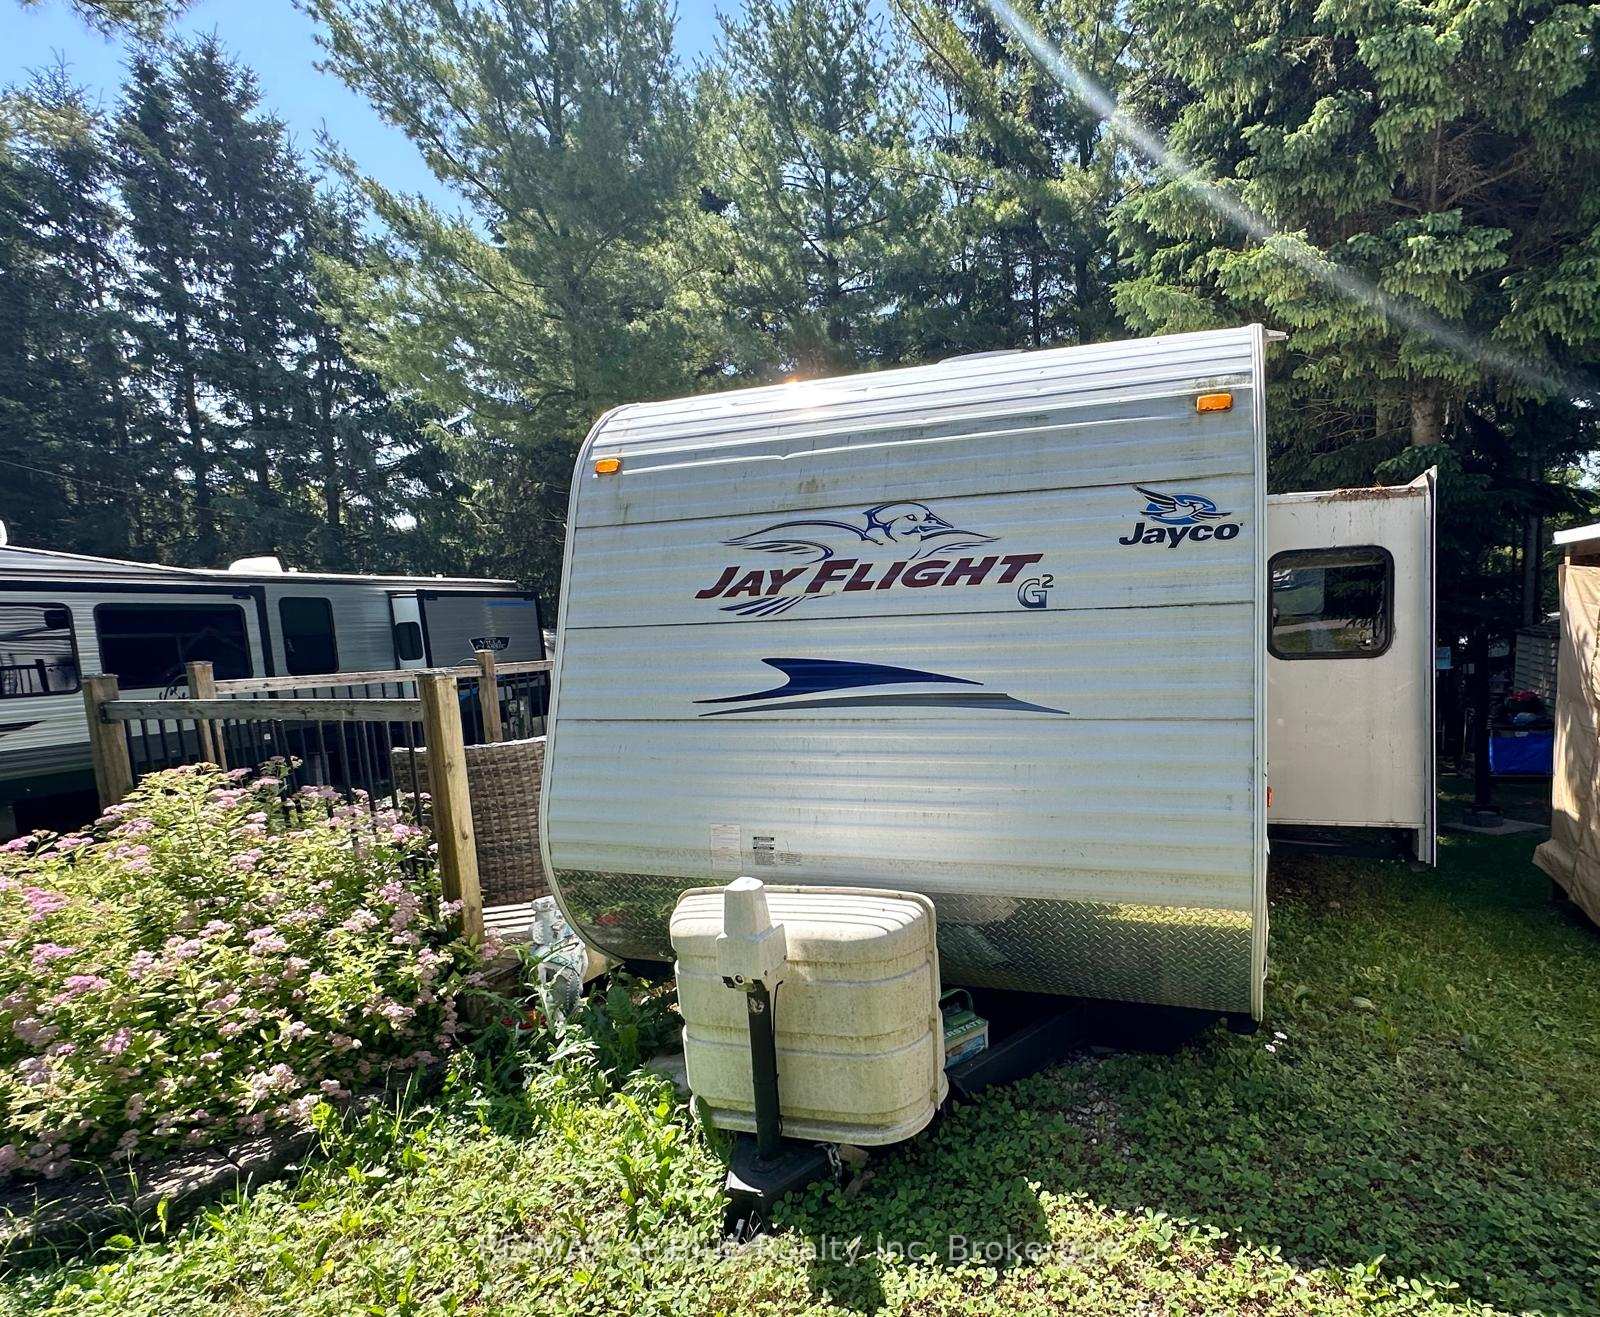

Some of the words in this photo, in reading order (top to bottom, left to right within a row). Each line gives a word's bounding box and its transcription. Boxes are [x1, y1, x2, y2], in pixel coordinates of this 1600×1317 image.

[1118, 522, 1240, 548] Jayco
[694, 566, 809, 599] JAY
[804, 553, 1044, 594] FLIGHT
